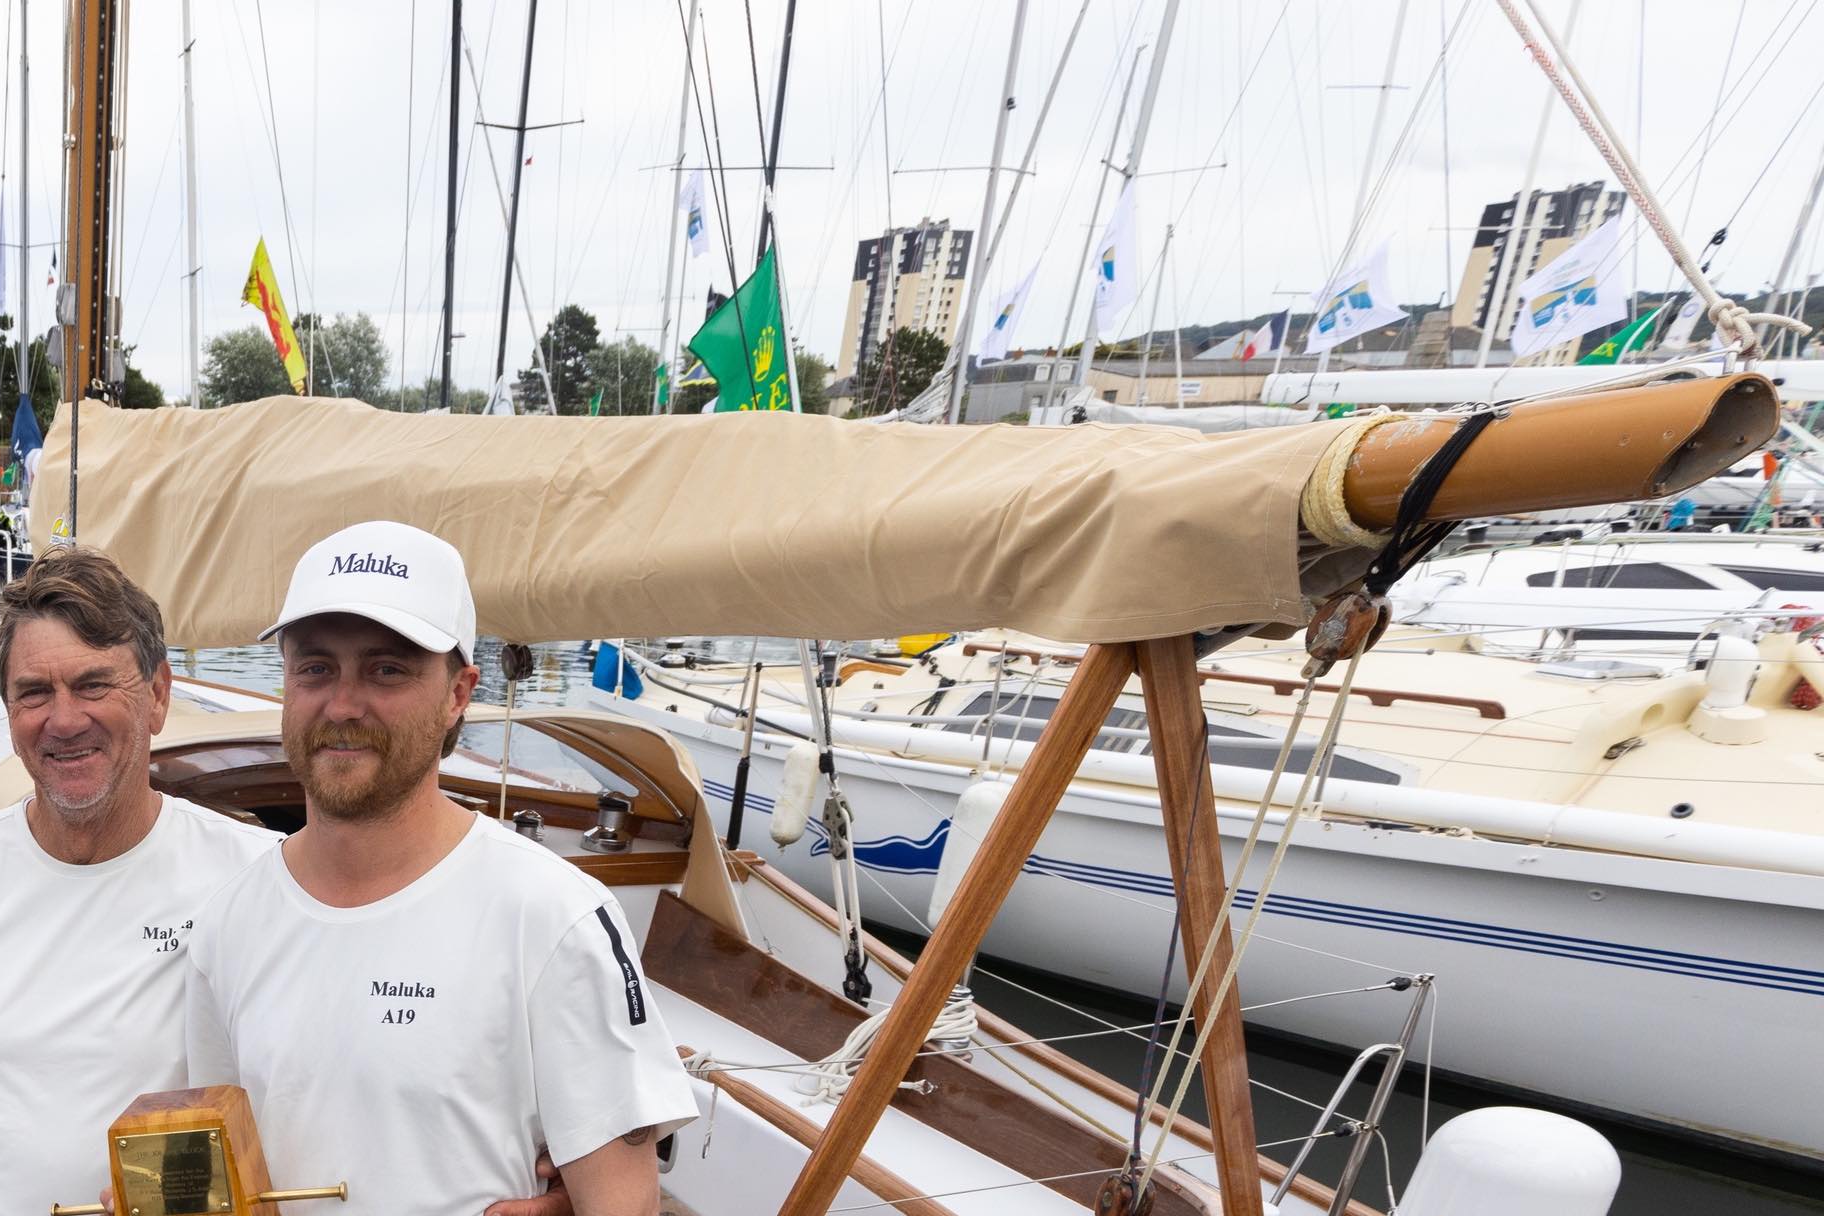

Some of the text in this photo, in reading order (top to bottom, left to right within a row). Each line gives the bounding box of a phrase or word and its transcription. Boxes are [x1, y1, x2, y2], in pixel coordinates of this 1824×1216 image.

[328, 552, 409, 579] Maluka
[370, 981, 436, 999] Maluka
[381, 1008, 416, 1025] A19
